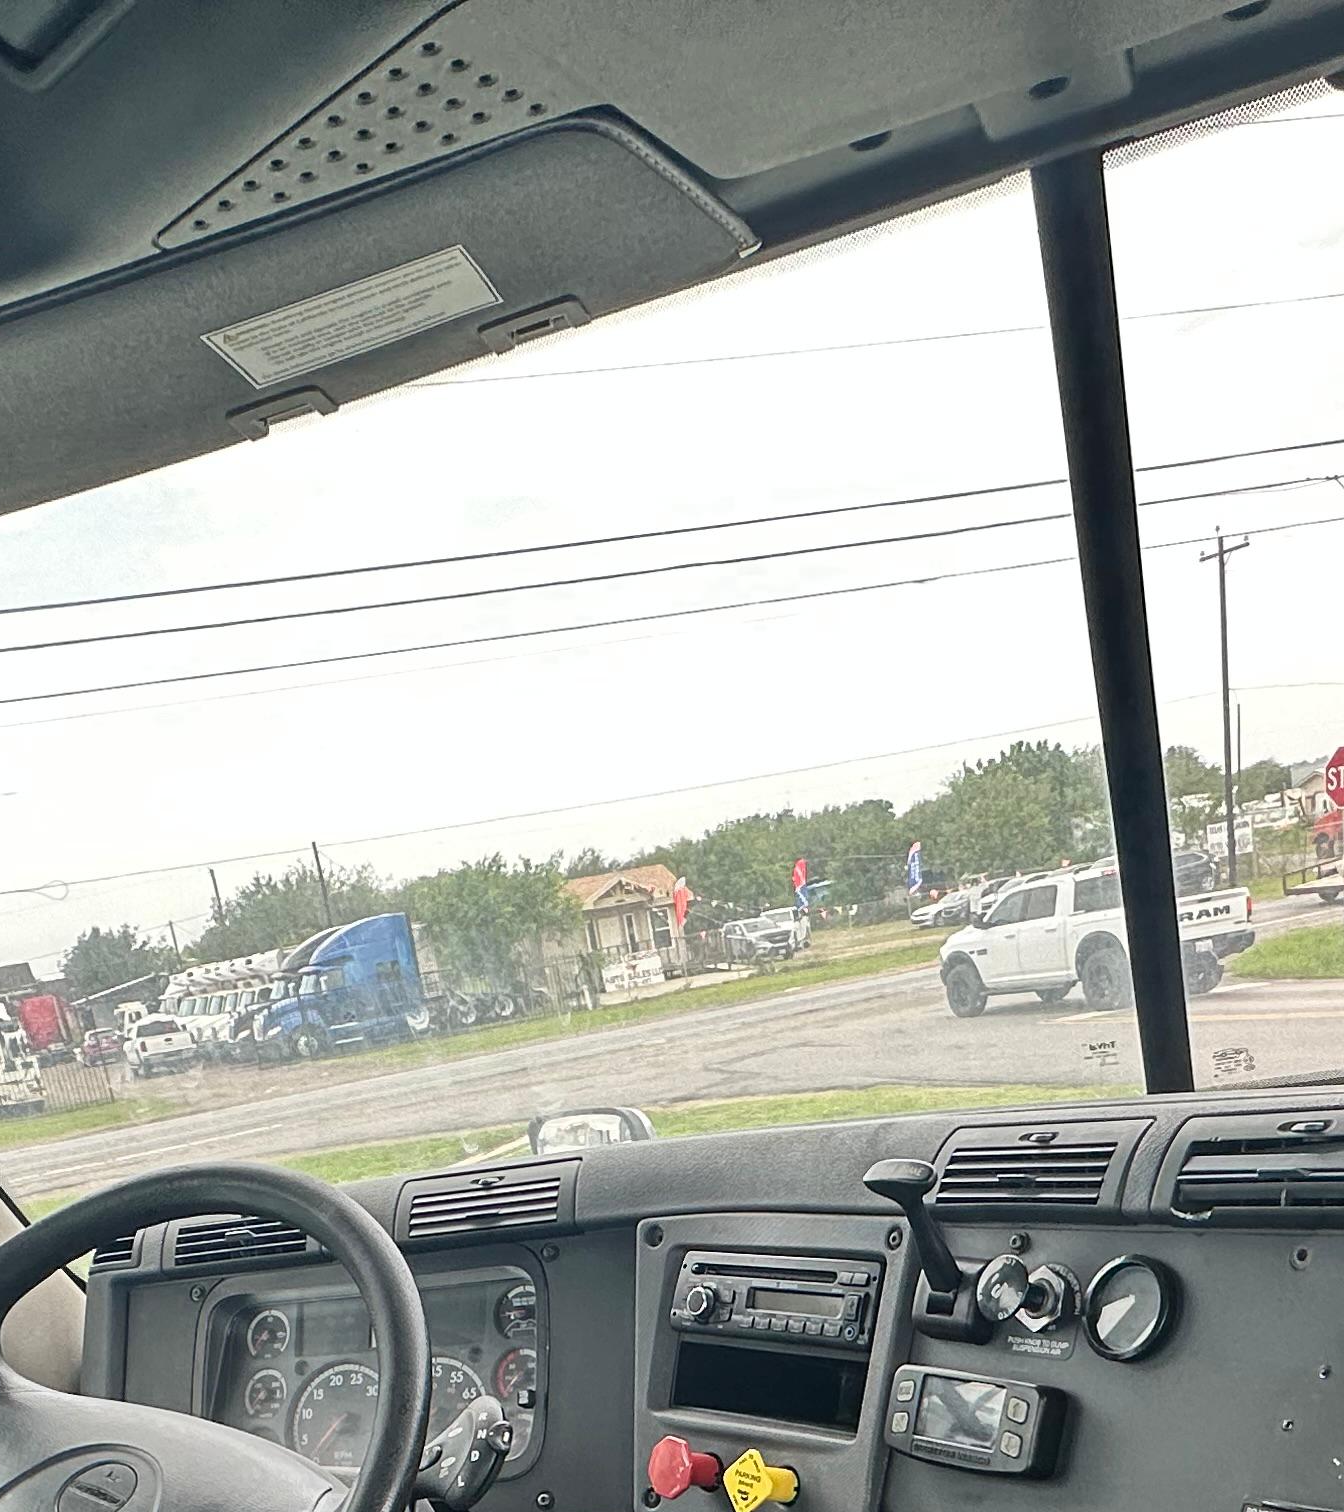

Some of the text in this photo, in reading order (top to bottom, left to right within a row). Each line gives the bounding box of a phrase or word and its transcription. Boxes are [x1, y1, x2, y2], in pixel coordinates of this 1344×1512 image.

[1178, 904, 1231, 922] RAM
[329, 1374, 344, 1387] 20
[350, 1373, 364, 1386] 25
[449, 1370, 464, 1384] 55
[313, 1388, 325, 1400] 15
[365, 1385, 379, 1397] 30
[462, 1386, 477, 1400] 65
[302, 1407, 313, 1420] 10
[301, 1433, 308, 1446] 5
[477, 1429, 487, 1439] N
[470, 1450, 480, 1462] D
[457, 1475, 465, 1487] L
[734, 1468, 761, 1484] PARKING
